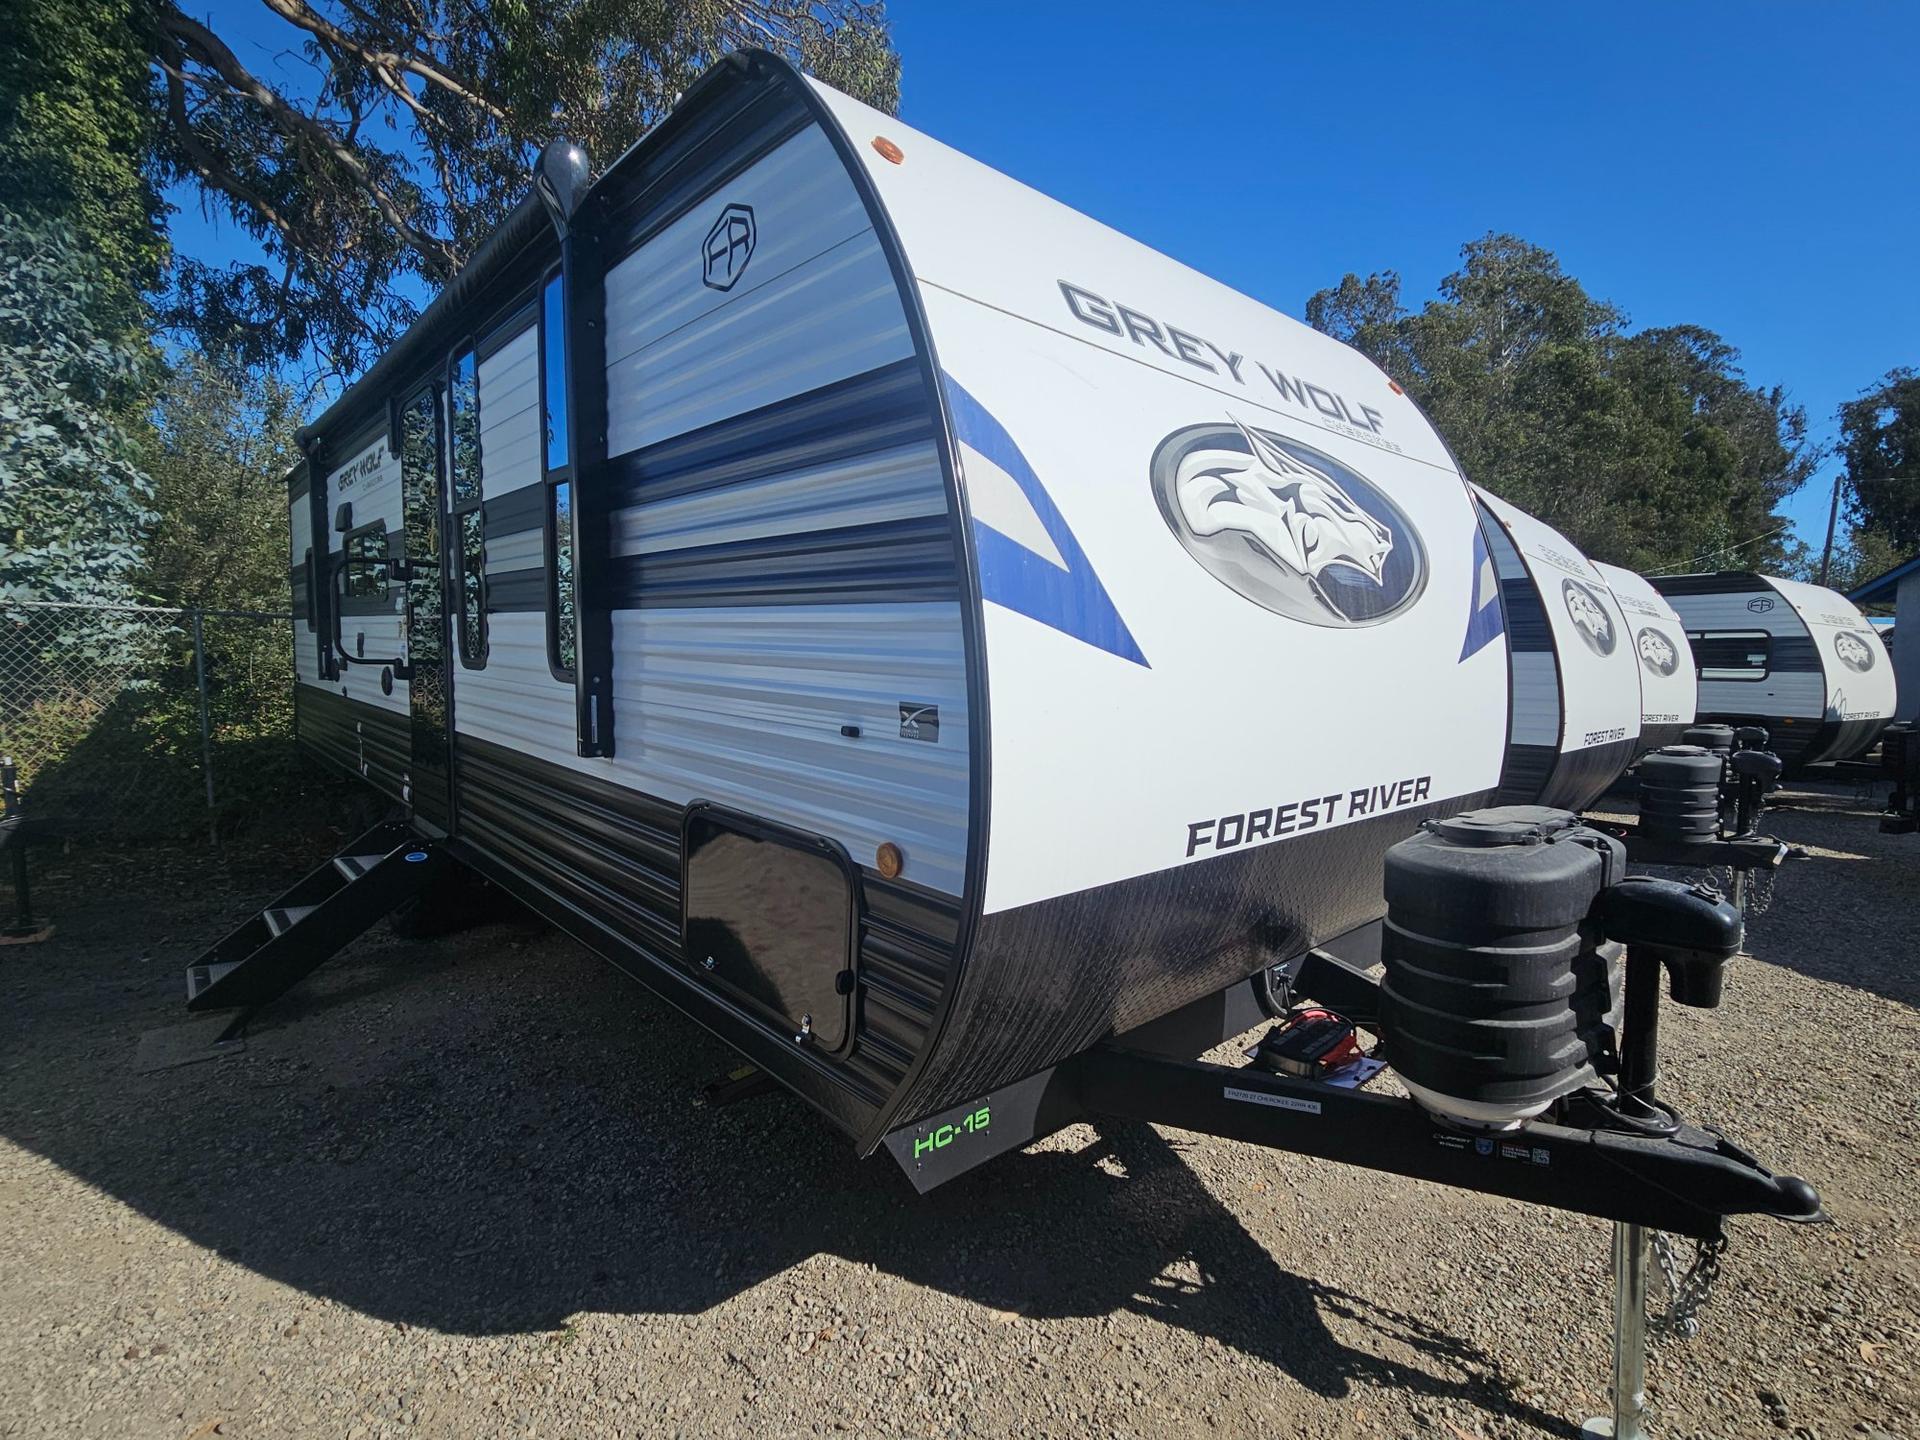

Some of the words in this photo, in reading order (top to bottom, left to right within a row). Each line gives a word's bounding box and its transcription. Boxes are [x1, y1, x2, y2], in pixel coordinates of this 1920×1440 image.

[1057, 278, 1246, 386] GREY
[1254, 359, 1384, 436] WOLF
[338, 462, 358, 491] GREY
[359, 445, 384, 479] WOLF
[1583, 730, 1609, 746] FOREST
[1609, 727, 1626, 742] RIVER
[1663, 714, 1679, 722] RIVER
[1186, 793, 1343, 858] FOREST
[1348, 775, 1432, 818] RIVER
[914, 1106, 991, 1159] HC-15
